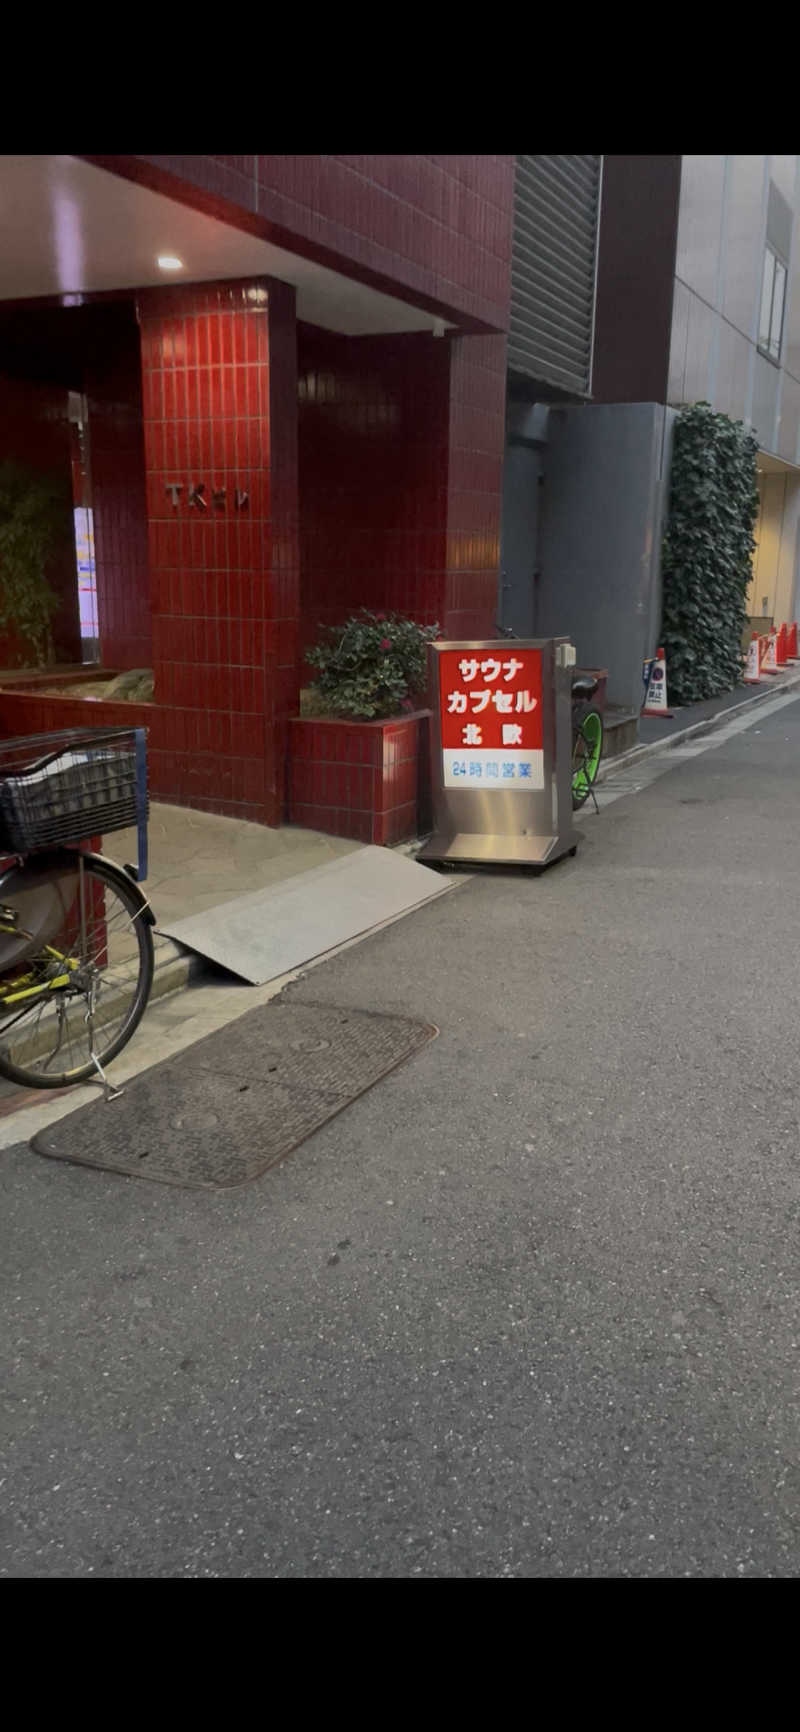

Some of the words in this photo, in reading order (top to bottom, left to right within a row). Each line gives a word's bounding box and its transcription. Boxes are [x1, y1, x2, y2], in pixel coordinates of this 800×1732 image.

[458, 658, 524, 682] サウナ
[447, 690, 537, 714] カプセル
[452, 761, 531, 778] 24時間営業
